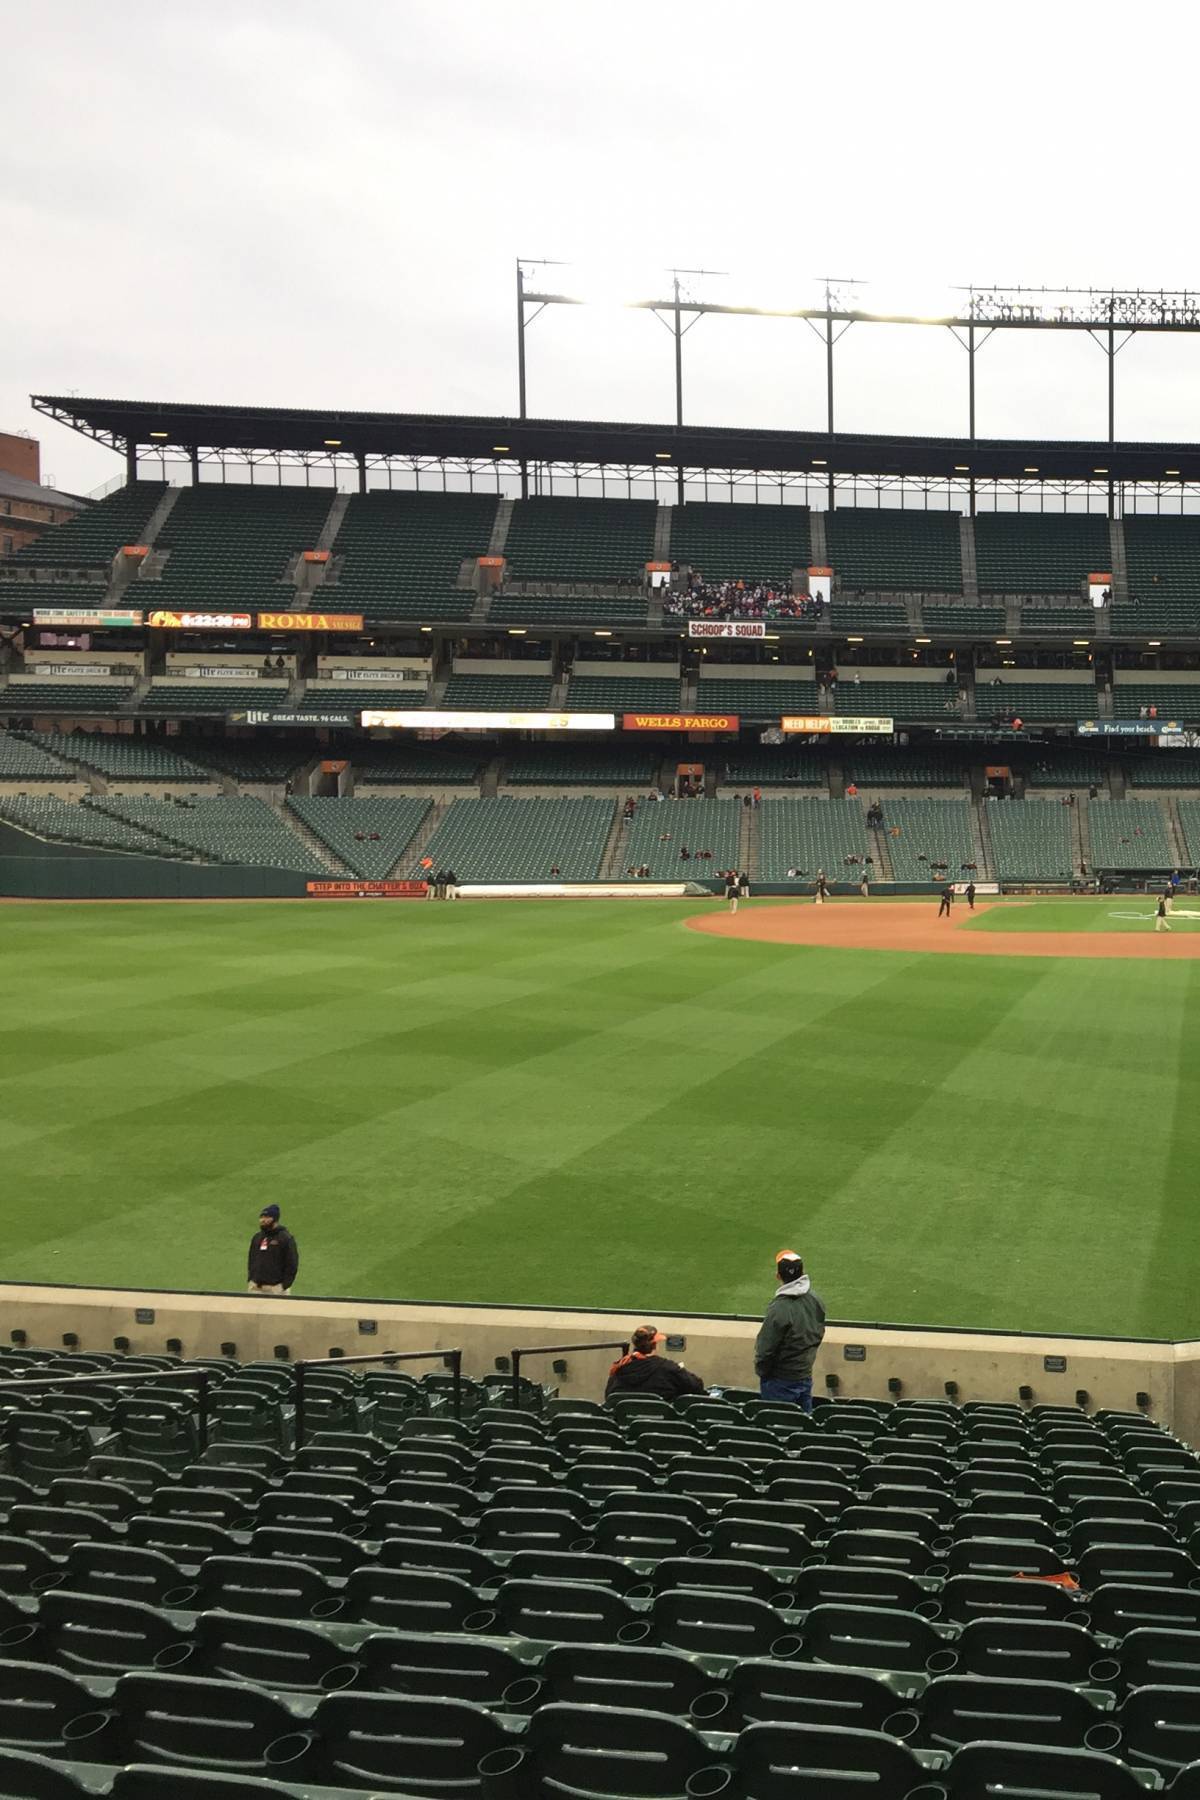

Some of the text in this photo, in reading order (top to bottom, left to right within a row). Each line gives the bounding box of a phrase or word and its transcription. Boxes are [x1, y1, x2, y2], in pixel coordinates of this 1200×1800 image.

[260, 614, 330, 629] ROMA
[691, 623, 763, 637] SCHOOP'S SQUAD
[246, 710, 270, 724] Lite
[296, 714, 320, 722] TASTE.
[635, 717, 729, 729] WELLS FARGO
[783, 720, 830, 730] NEED HELP?
[1103, 724, 1120, 733] Find
[1120, 726, 1136, 734] your
[1136, 724, 1156, 733] beach.
[314, 882, 333, 890] STEP
[333, 882, 352, 890] INTO
[353, 882, 366, 890] THE
